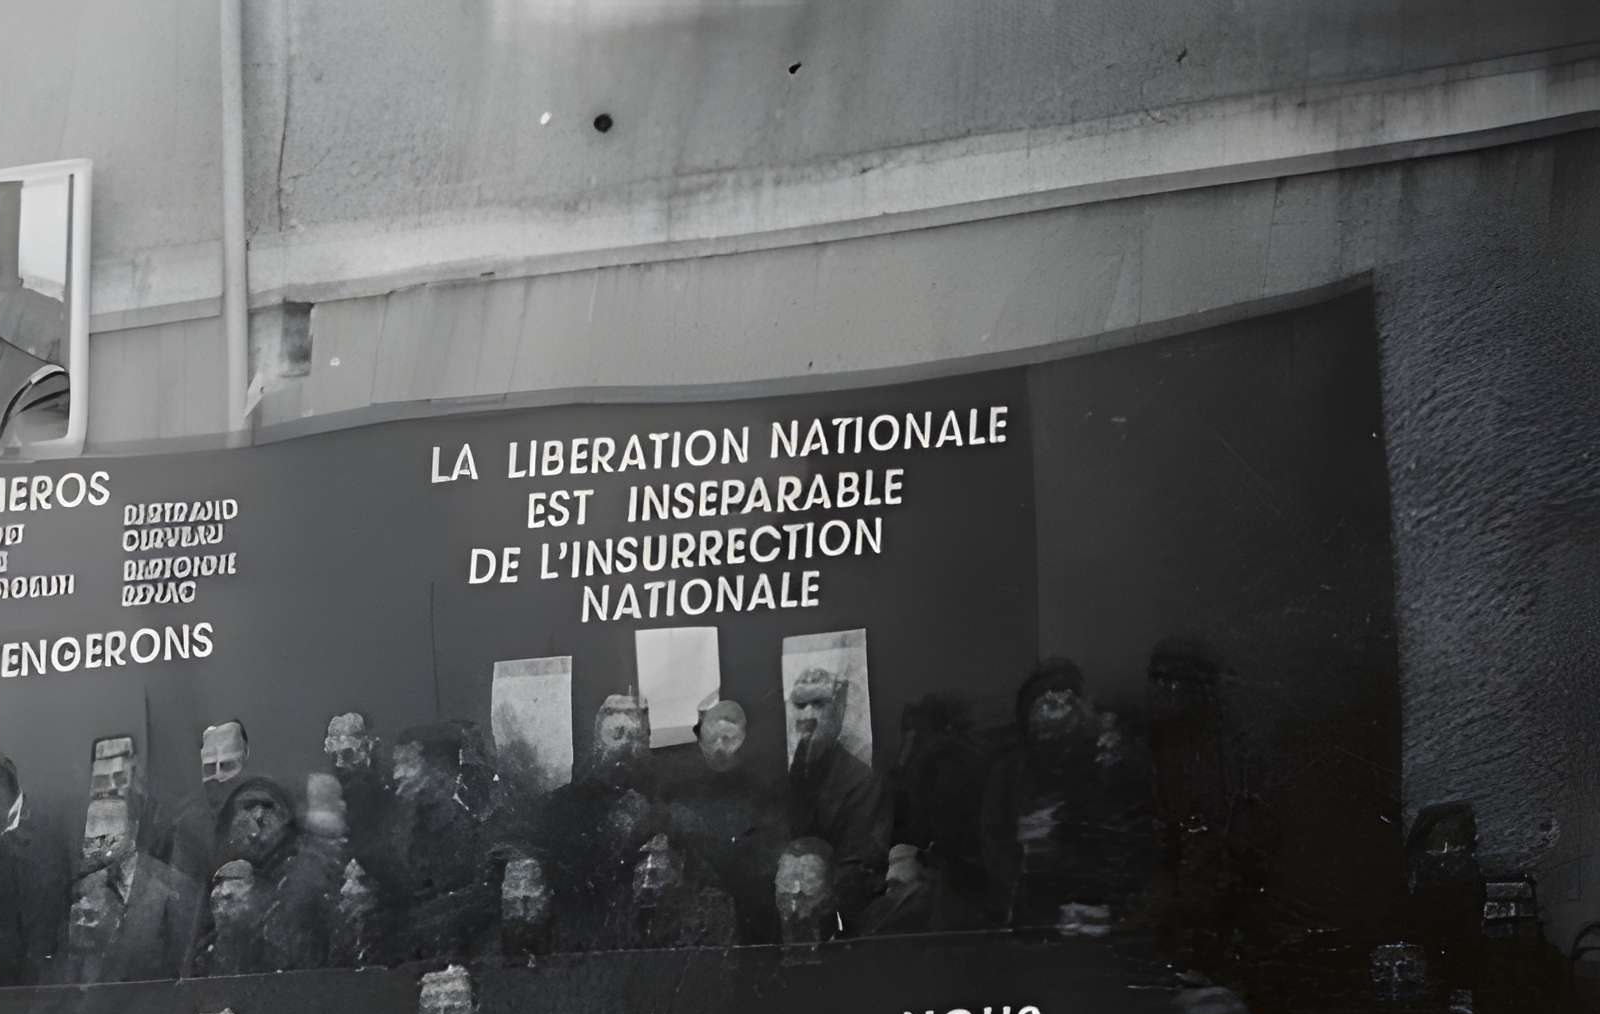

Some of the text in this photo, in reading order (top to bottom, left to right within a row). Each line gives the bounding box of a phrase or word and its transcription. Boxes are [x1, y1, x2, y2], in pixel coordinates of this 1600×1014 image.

[431, 406, 1008, 484] LA LIBERATION NATIONALE
[527, 468, 904, 529] EST INSEPARABLE
[468, 517, 883, 585] DE L'INSURRECTION
[581, 570, 821, 623] NATIONALE
